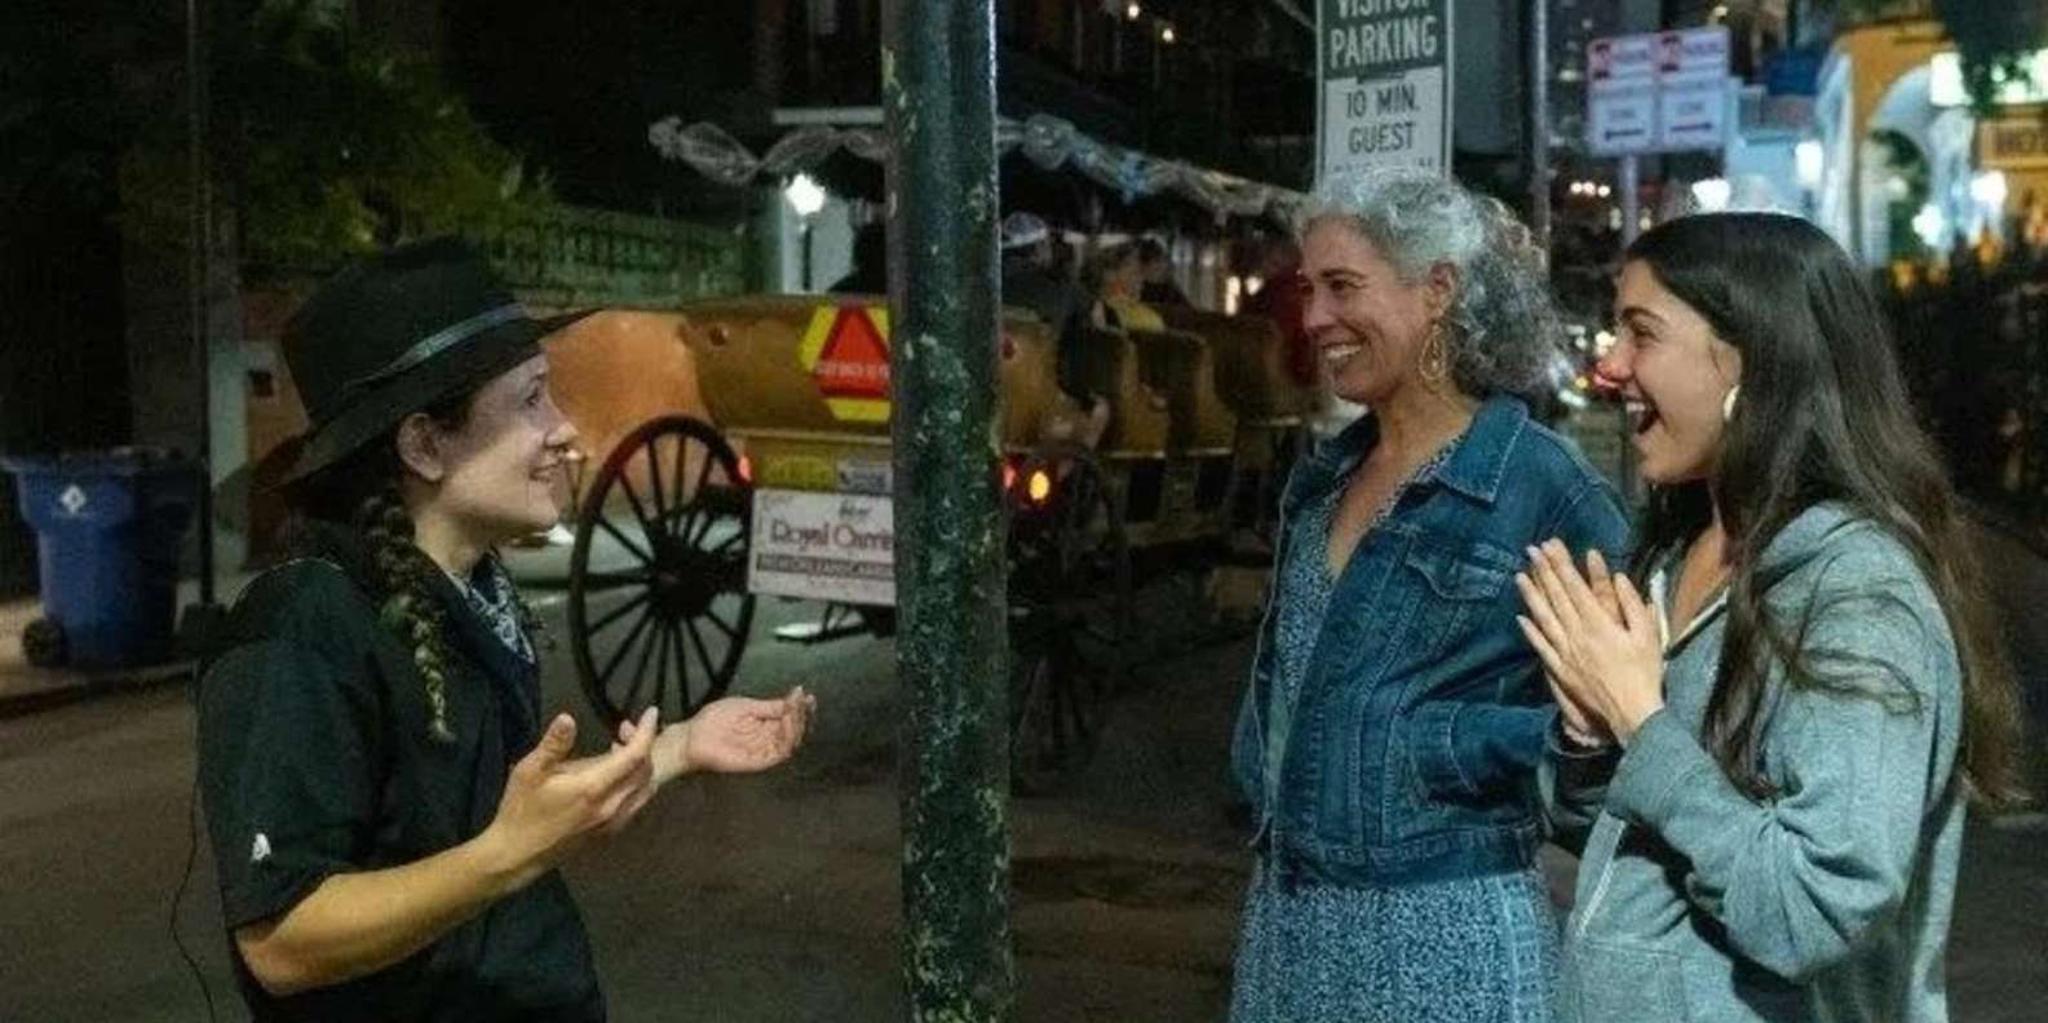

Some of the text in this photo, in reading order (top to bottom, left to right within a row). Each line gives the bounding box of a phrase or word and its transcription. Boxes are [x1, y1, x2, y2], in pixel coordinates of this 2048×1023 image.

[1330, 15, 1437, 69] PARKING
[1346, 83, 1420, 118] 10 MIN.
[1348, 120, 1415, 154] GUEST
[770, 517, 830, 551] Royal
